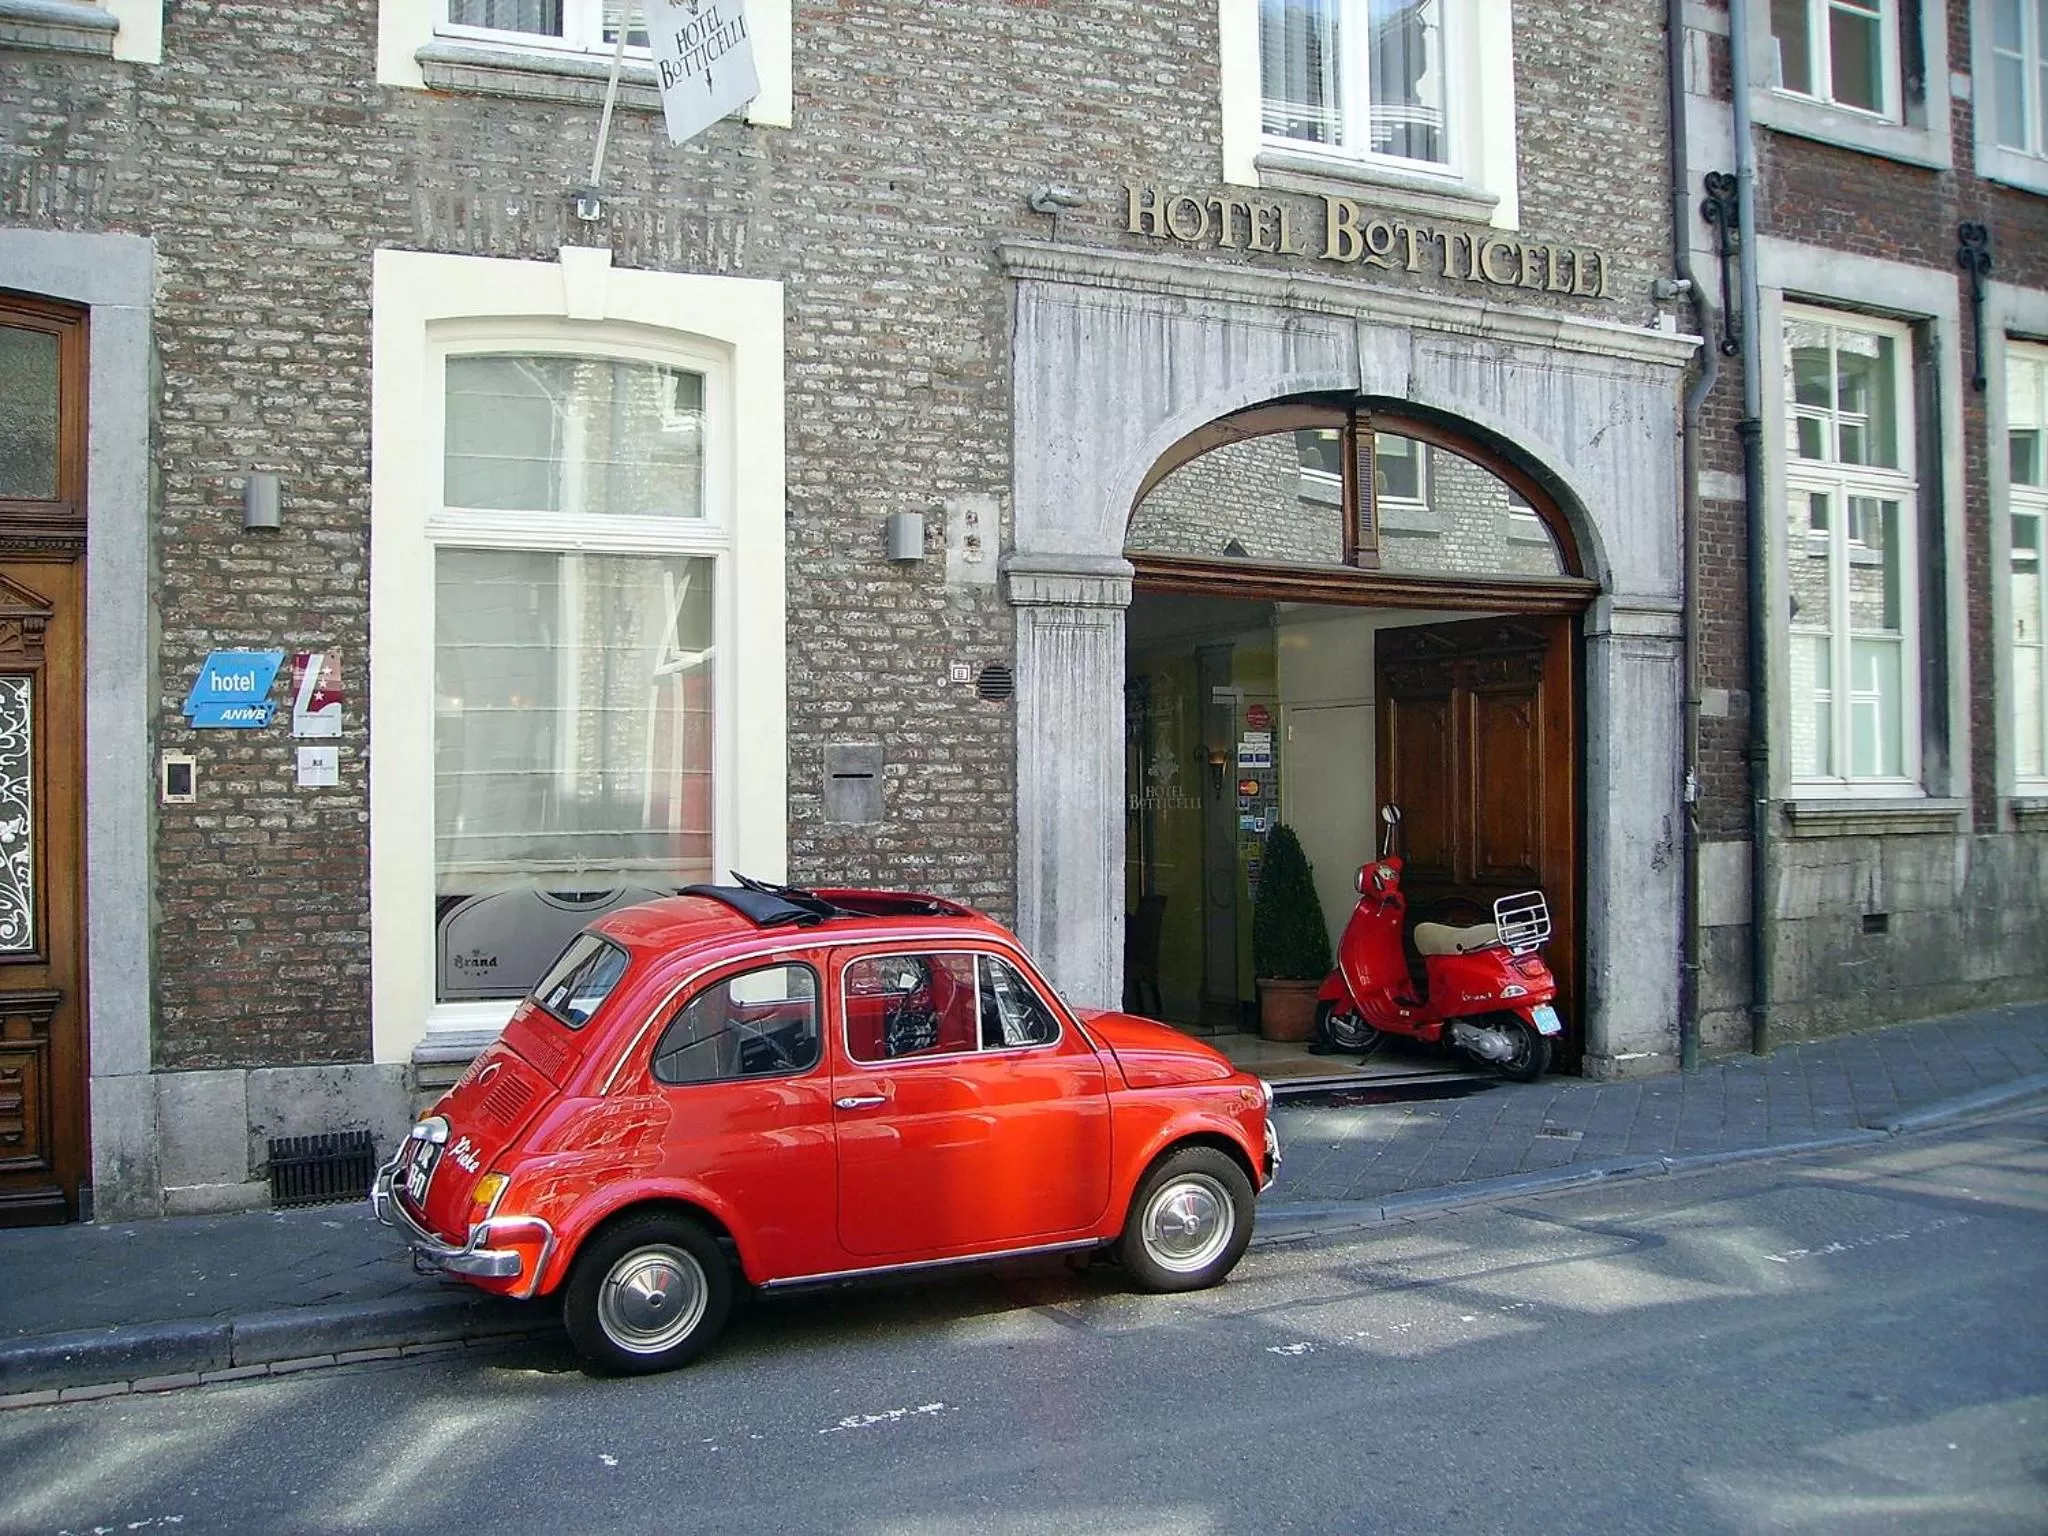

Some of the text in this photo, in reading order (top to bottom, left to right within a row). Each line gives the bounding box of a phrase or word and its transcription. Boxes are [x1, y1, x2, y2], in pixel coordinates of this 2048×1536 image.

[675, 5, 723, 54] HOTEL
[1122, 183, 1617, 300] HOTEL BOTTICELLI
[211, 670, 255, 692] hotel
[220, 708, 266, 721] ANWB
[1145, 785, 1184, 798] HOTEL
[453, 954, 498, 969] Brand
